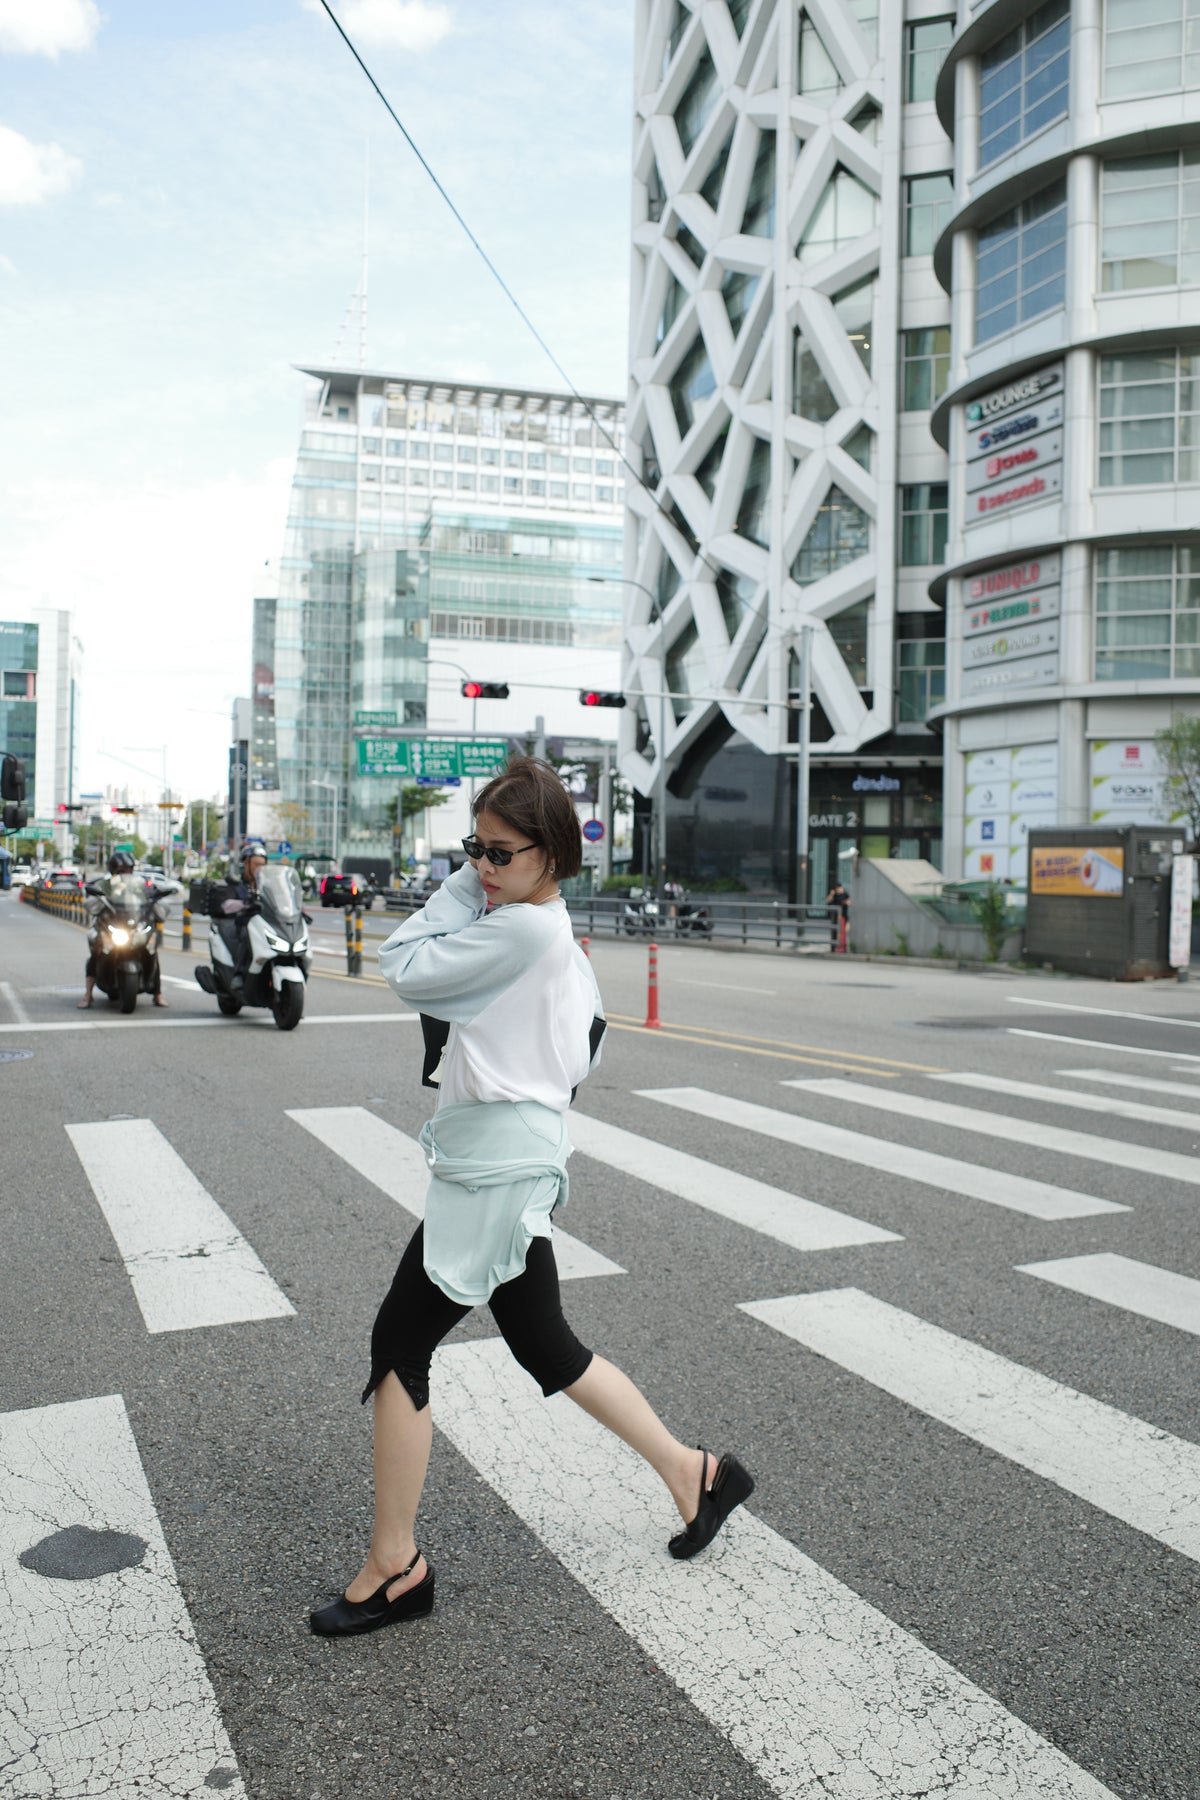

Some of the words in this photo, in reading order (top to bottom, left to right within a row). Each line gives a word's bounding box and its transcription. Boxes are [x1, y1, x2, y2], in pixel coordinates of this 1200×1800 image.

[982, 377, 1041, 415] LOUNGE
[989, 477, 1045, 508] seconds
[985, 562, 1039, 593] UNIQLO
[809, 814, 844, 828] GATE
[846, 811, 857, 828] 2
